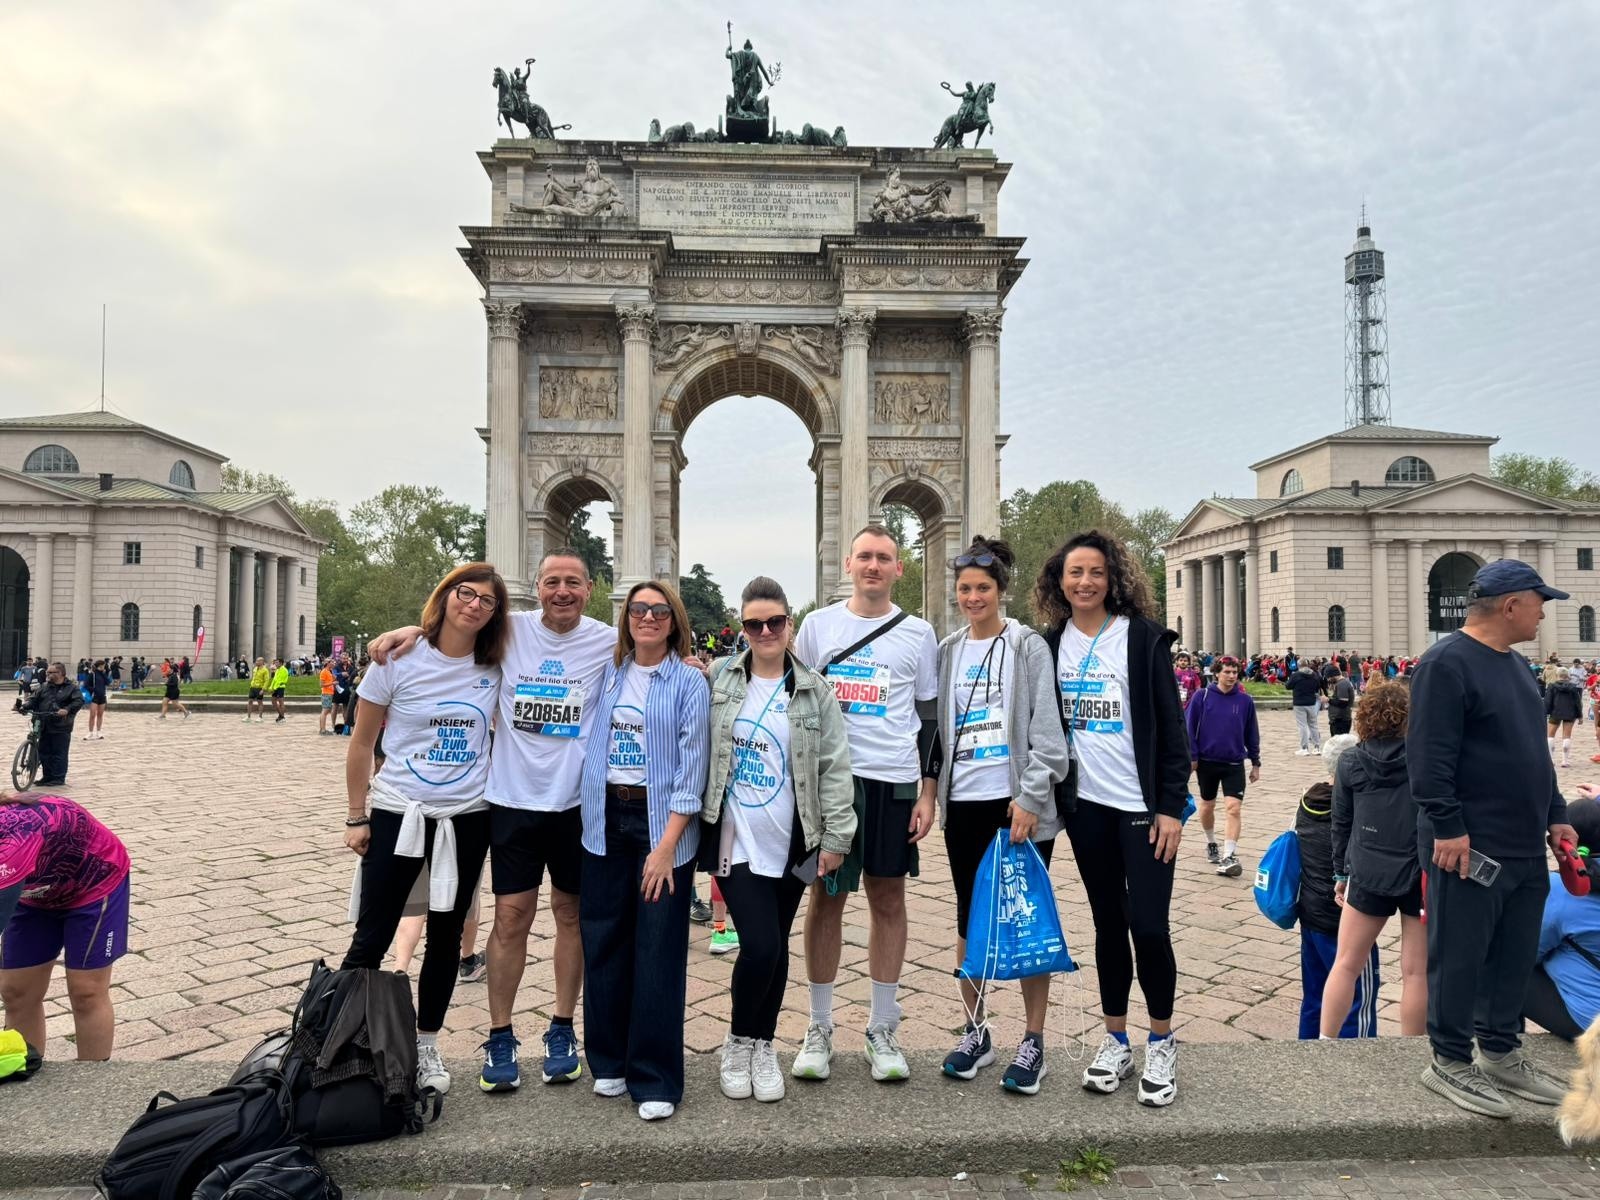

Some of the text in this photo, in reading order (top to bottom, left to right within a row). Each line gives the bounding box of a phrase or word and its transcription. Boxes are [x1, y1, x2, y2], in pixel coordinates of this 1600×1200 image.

[518, 673, 533, 682] lega
[522, 702, 571, 724] 2085A
[429, 718, 476, 728] INSIEME
[610, 722, 644, 733] NSIEME
[437, 727, 467, 738] OLTRE
[441, 738, 468, 751] BUIO
[618, 742, 642, 753] BUIO
[732, 736, 769, 752] NSIEME
[428, 749, 476, 763] SILENZIO
[609, 754, 646, 766] SILENZI
[741, 759, 765, 774] BUIO
